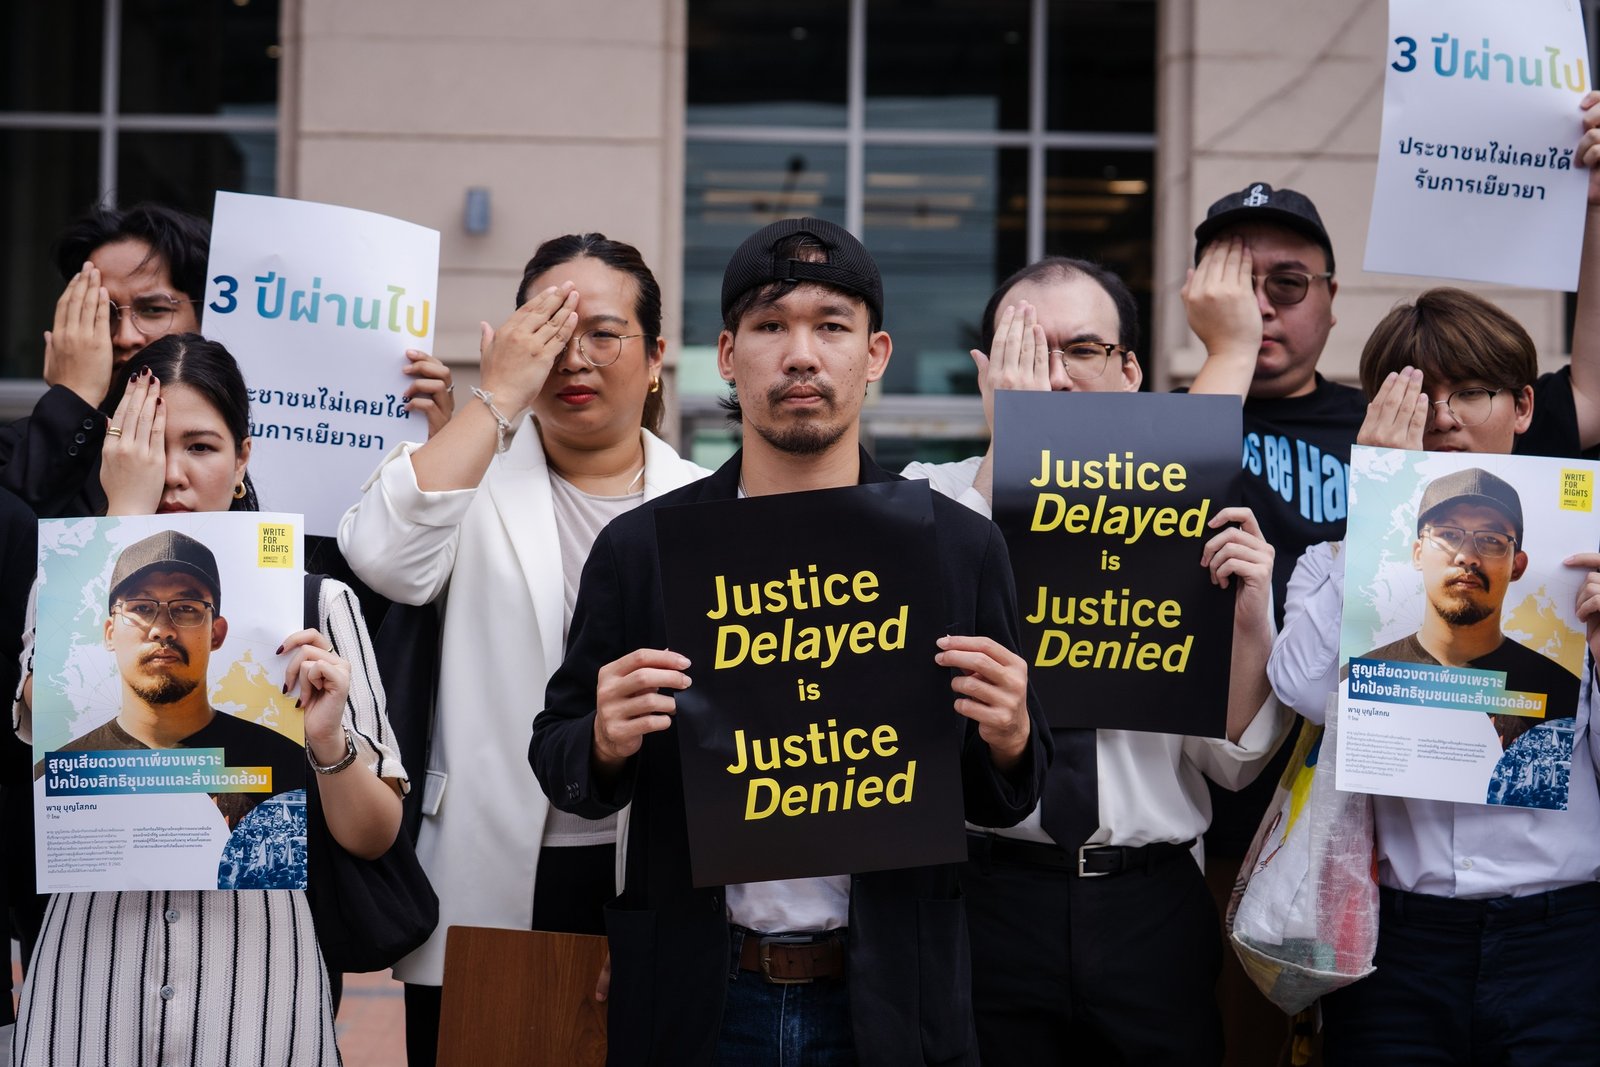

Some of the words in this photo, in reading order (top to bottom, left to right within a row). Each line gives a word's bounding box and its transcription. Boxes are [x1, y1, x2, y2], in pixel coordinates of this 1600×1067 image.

[1391, 36, 1417, 73] 3
[1431, 32, 1586, 93] ปีผ่านไป
[1399, 136, 1573, 171] ประชาชนไม่เคยได้
[1414, 168, 1546, 200] รับการเยียวยา
[208, 275, 238, 314] 3
[254, 271, 430, 338] ปีผ่านไป
[246, 386, 412, 420] ะชาชนไม่เคยได้
[248, 422, 384, 450] บการเยียวยา
[1029, 449, 1187, 492] Justice
[1296, 439, 1351, 523] Ha
[1564, 473, 1585, 481] WRITE
[1564, 489, 1588, 498] RIGHTS
[262, 528, 285, 536] WRITE
[1030, 492, 1210, 545] Delayed
[262, 536, 277, 544] FOR
[262, 545, 289, 553] RIGHTS
[1101, 550, 1120, 570] is
[706, 565, 880, 619] Justice
[1026, 586, 1182, 629] Justice
[714, 605, 909, 669] Delayed
[1034, 629, 1194, 673] Denied
[797, 678, 821, 702] is
[1351, 662, 1503, 689] สูญเสียดวงตาเพียงเพราะ
[1351, 680, 1542, 711] ปกป้องสิทธิชุมชนและสิ่งแวดล้อม
[726, 719, 898, 774] Justice
[48, 753, 221, 774] สูญเสียดวงตาเพียงเพราะ
[49, 769, 268, 791] ปกป้องสิทธิชุมชนและสิ่งแวดล้อม
[744, 760, 916, 820] Denied
